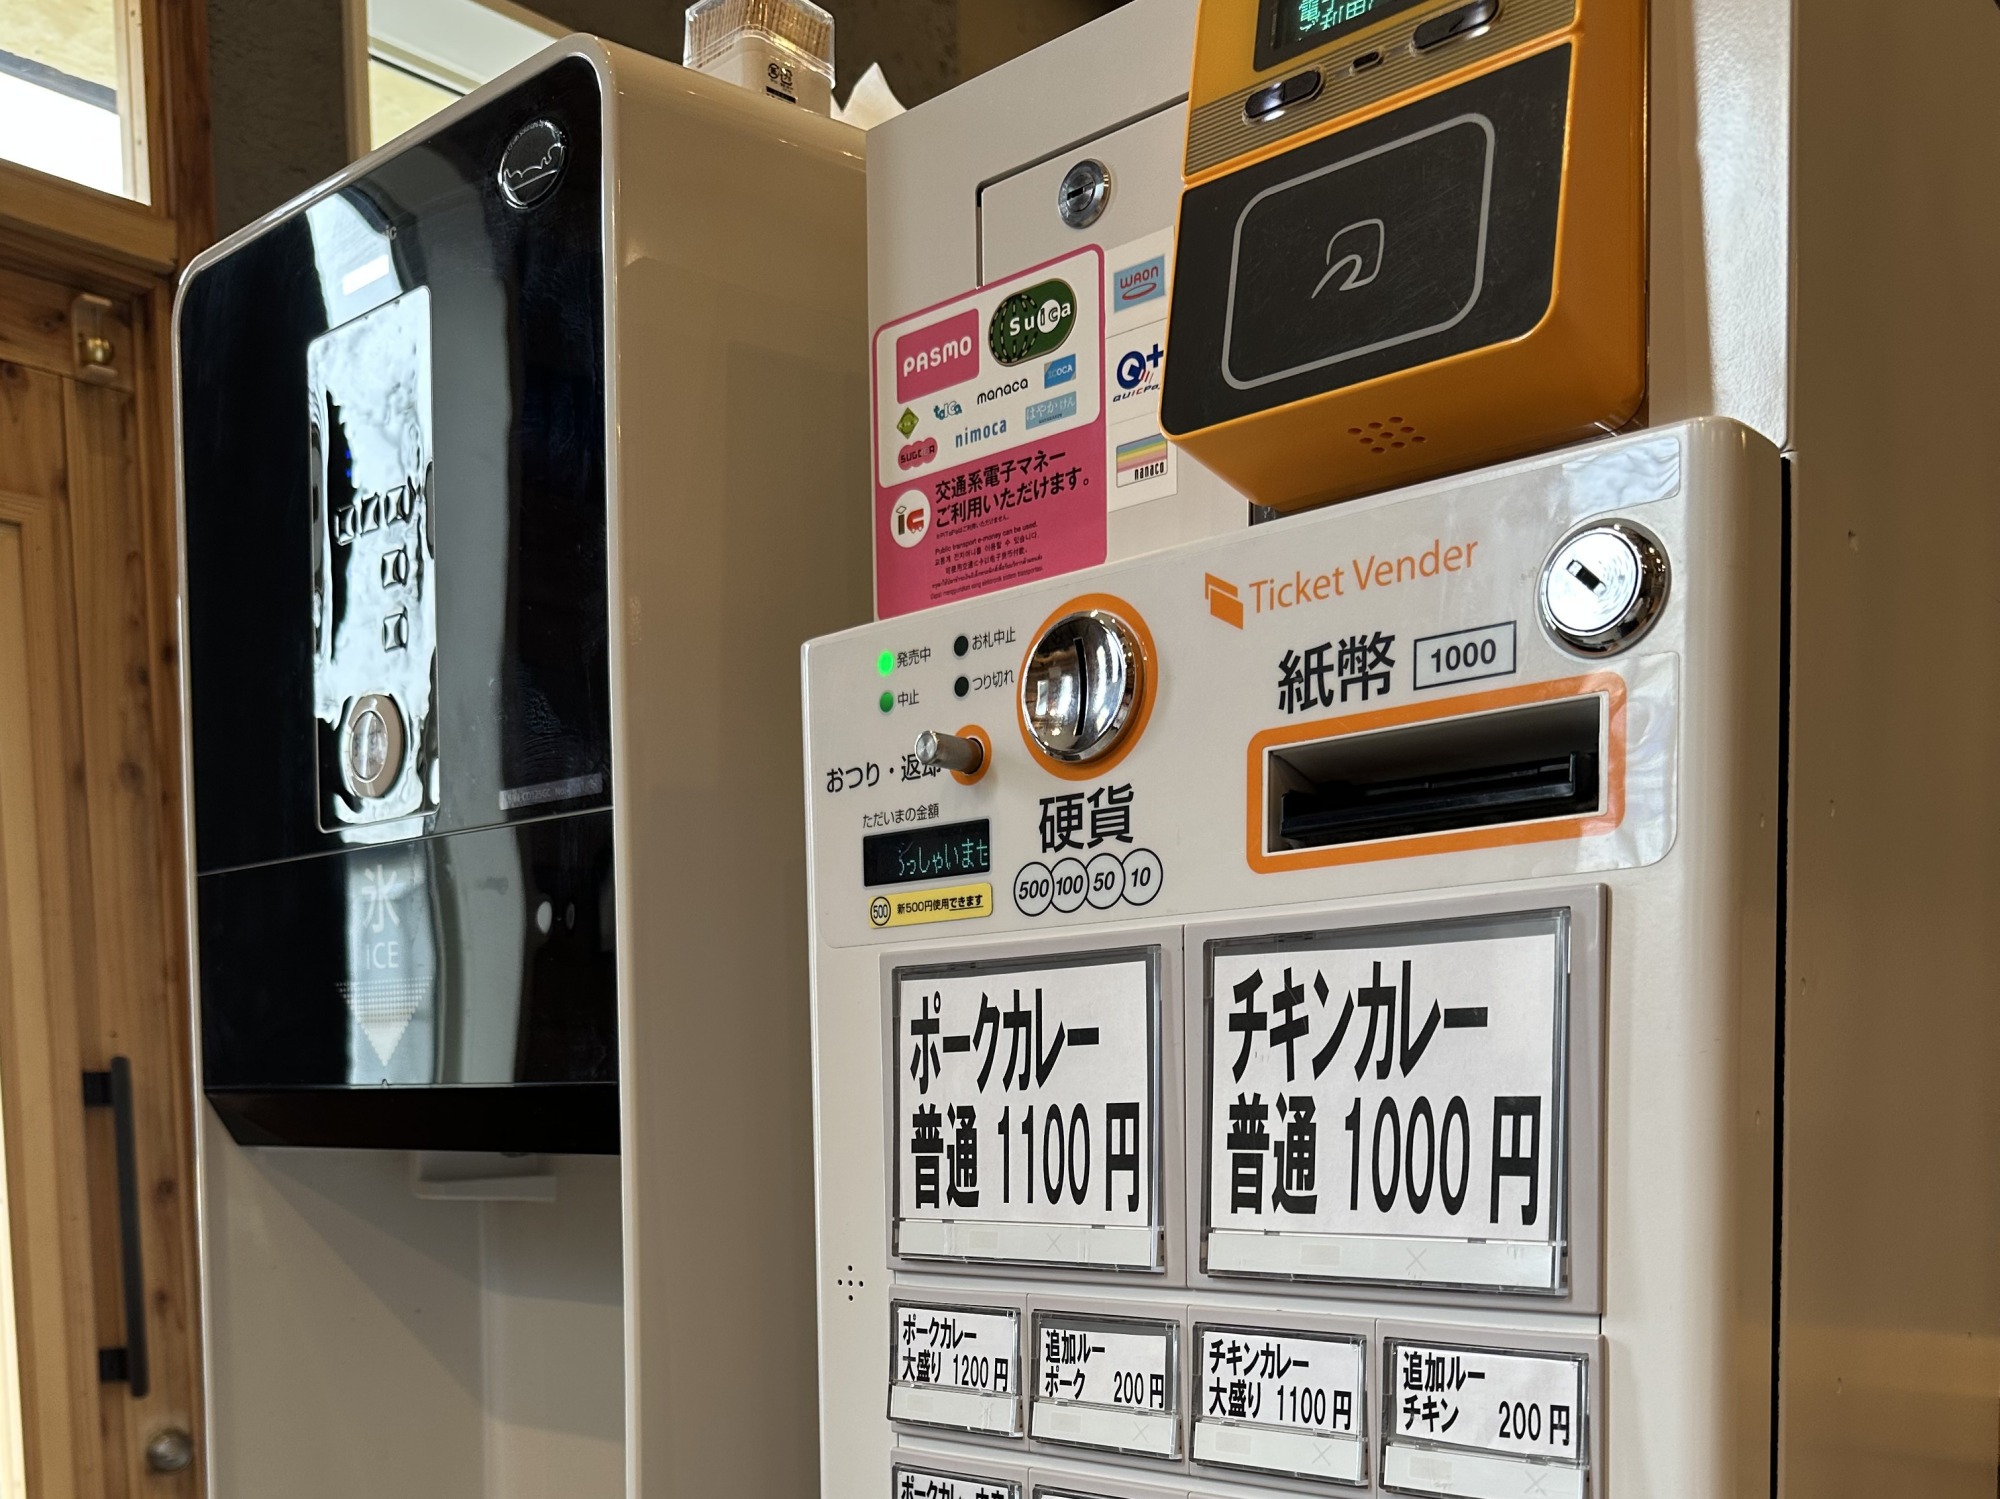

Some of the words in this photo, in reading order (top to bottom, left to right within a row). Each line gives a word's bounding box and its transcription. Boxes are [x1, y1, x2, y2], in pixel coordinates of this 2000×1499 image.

[1120, 266, 1158, 289] WAON
[1009, 303, 1072, 336] Suica
[903, 336, 972, 377] PASMO
[977, 378, 1028, 405] manaca
[1026, 396, 1075, 420] はやかけん
[1113, 384, 1160, 402] QUICPa
[955, 419, 1006, 448] nimoca
[936, 450, 1066, 503] 交通系電子マネー
[1134, 462, 1164, 480] nanaco
[936, 467, 1089, 527] ご利用いただけます。
[1249, 566, 1344, 613] Ticket
[1352, 539, 1478, 591] Vender
[972, 626, 1016, 650] お札中止
[896, 647, 931, 669] 発売中
[1278, 631, 1396, 714] 紙幣
[1431, 638, 1496, 673] 1000
[972, 669, 1015, 691] つり切れ
[897, 690, 920, 707] 中止
[862, 803, 940, 828] ただいまの金額
[1039, 784, 1134, 854] 硬貨
[362, 864, 400, 933] 氷
[1019, 880, 1049, 900] 500
[1055, 875, 1084, 895] 100
[1092, 870, 1115, 891] 50
[1131, 866, 1151, 887] 10
[873, 904, 888, 919] 500
[897, 894, 983, 914] 新500円使用できます
[366, 942, 399, 969] ICE
[1229, 960, 1488, 1084] チキンカレー
[910, 988, 1100, 1094] ポークカレー
[911, 1102, 979, 1208] 普通
[1227, 1092, 1318, 1214] 普通
[902, 1313, 977, 1349] ポークカレー
[1045, 1329, 1105, 1365] 追加ルー
[902, 1348, 941, 1383] 大盛り
[1209, 1339, 1309, 1379] チキンカレー
[1403, 1351, 1485, 1392] 追加ルー
[1045, 1365, 1085, 1400] ポーク
[1209, 1376, 1260, 1419] 大盛り
[1403, 1395, 1459, 1433] チキン
